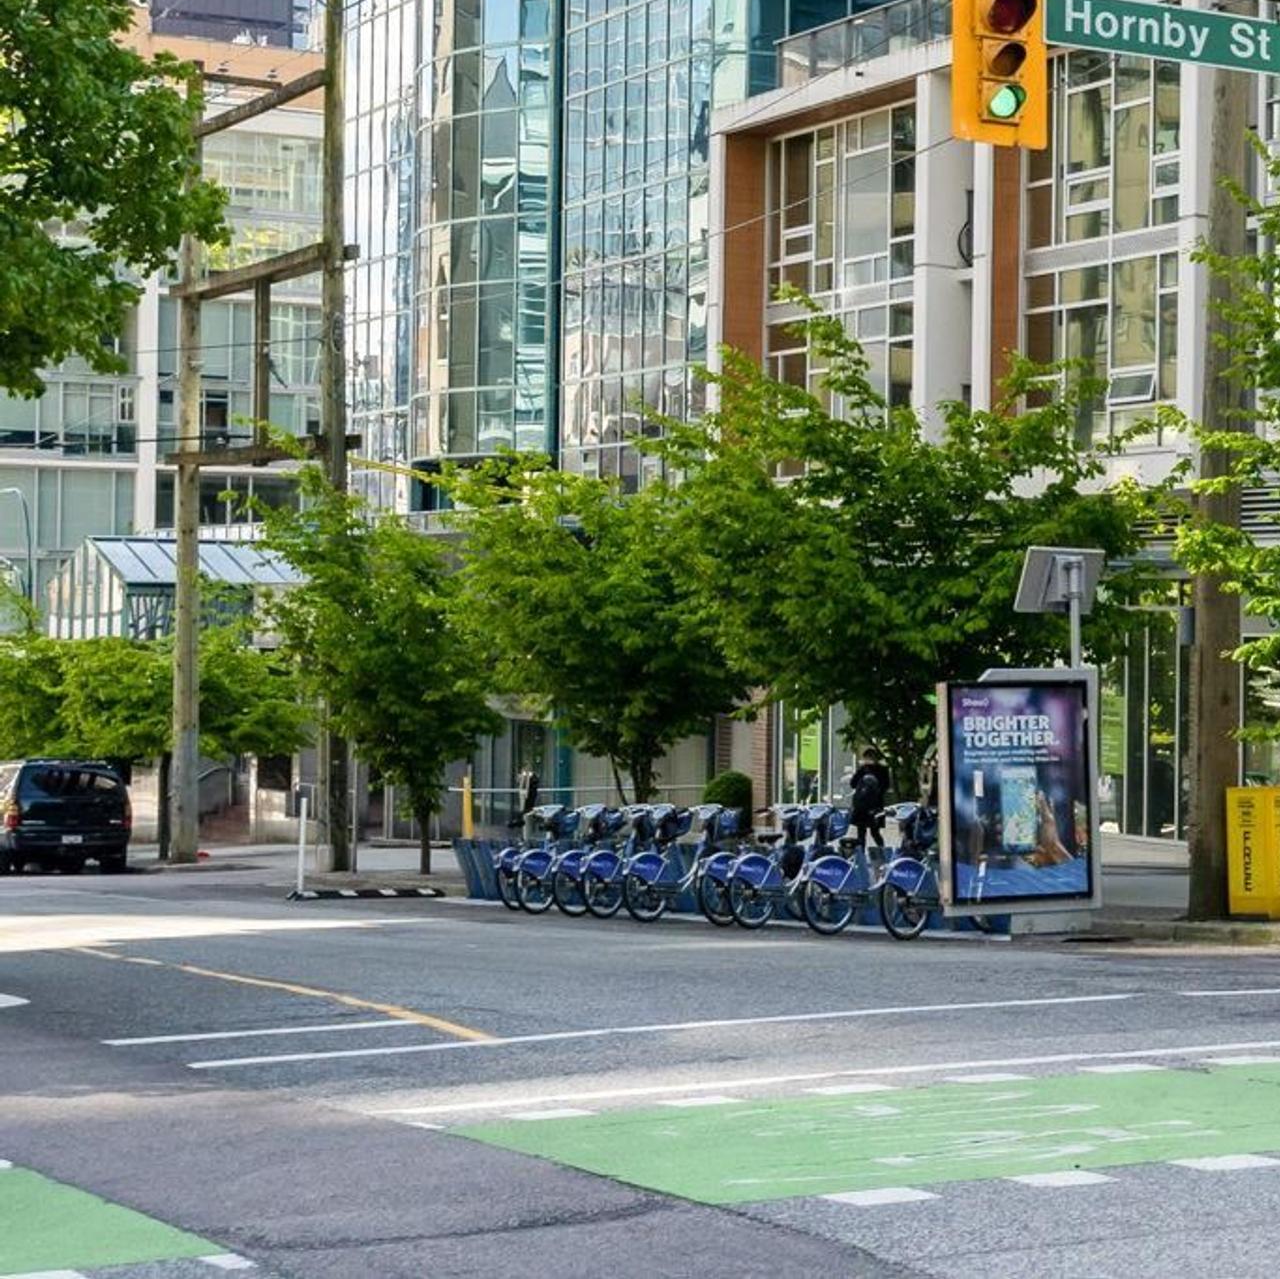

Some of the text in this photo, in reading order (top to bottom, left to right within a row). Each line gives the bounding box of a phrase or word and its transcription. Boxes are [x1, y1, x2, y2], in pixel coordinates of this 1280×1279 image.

[1230, 23, 1271, 60] St
[963, 714, 1050, 731] BRIGHTER
[964, 731, 1060, 748] TOGETHER.
